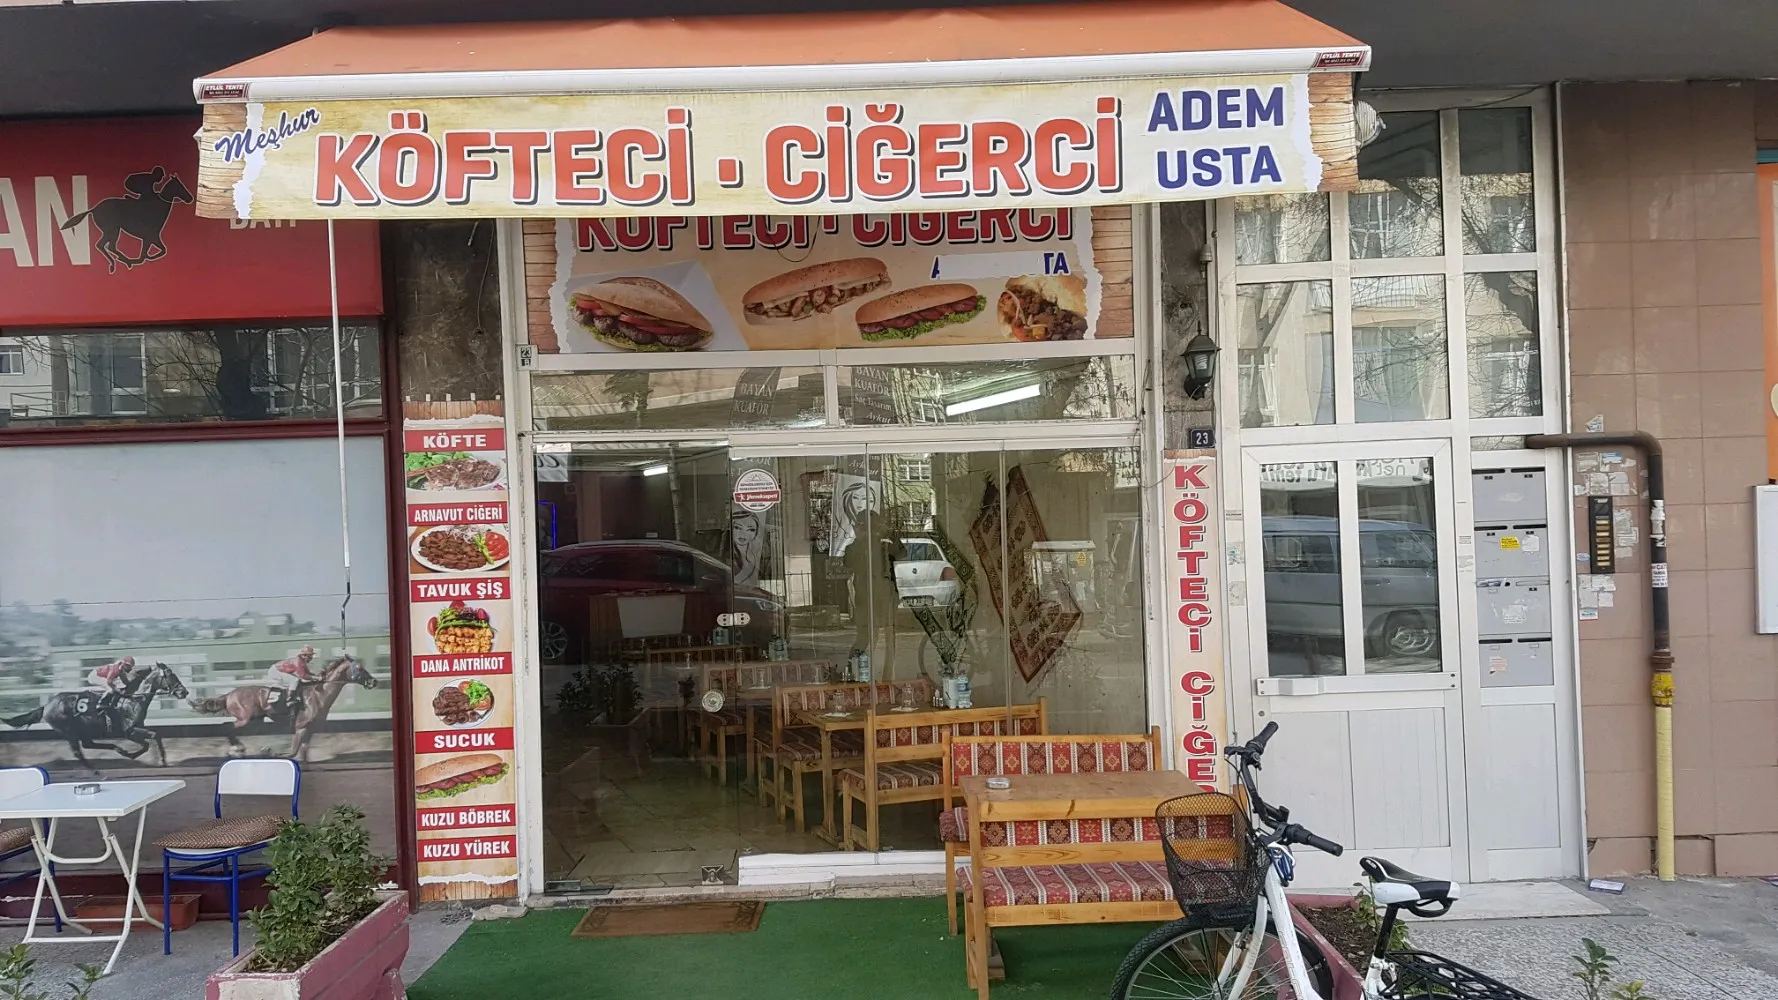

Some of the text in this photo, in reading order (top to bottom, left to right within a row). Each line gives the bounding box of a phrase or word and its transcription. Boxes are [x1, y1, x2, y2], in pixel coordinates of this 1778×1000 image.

[1148, 87, 1284, 132] ADEM
[215, 108, 320, 162] Meşhur
[314, 97, 1122, 206] KÖFTECİ CİĞERCİ
[1157, 145, 1282, 189] USTA
[423, 432, 487, 449] KÖFTE
[1196, 432, 1209, 445] 23
[414, 504, 503, 523] ARNAVUT CİĞERİ
[1173, 464, 1212, 653] KÖFTECİ
[417, 579, 503, 599] TAVUK ŞİŞ
[421, 655, 505, 673] DANA ANTRİKOT
[434, 733, 496, 749] SUCUK
[421, 808, 511, 827] KUZU BÖBREK
[423, 839, 510, 858] KUZU YÜREK
